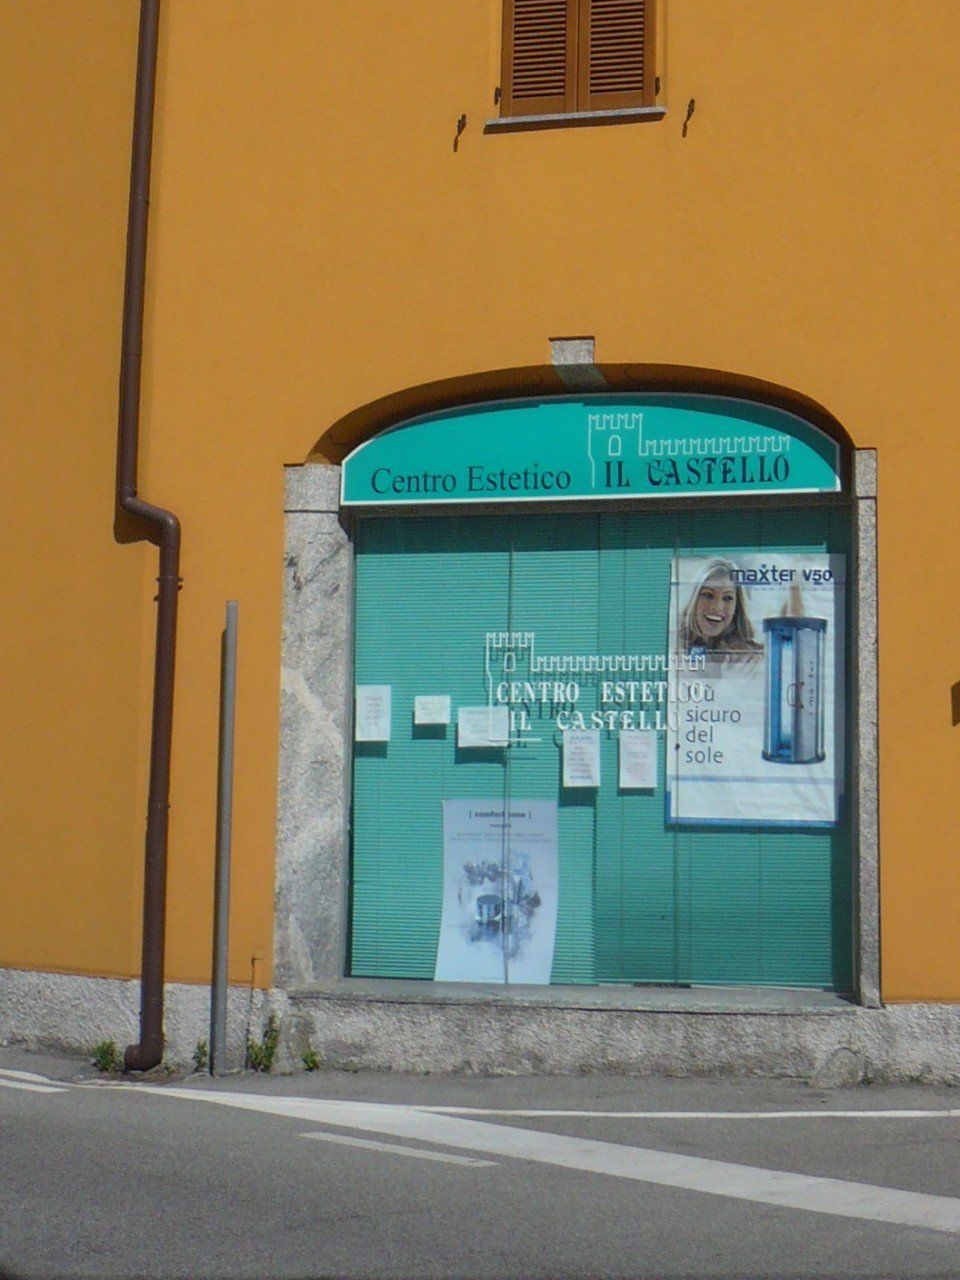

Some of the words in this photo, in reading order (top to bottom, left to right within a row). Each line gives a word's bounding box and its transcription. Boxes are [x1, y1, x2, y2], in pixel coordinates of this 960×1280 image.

[370, 467, 457, 494] Centro
[467, 462, 572, 492] Estetico
[604, 460, 631, 488] IL
[647, 454, 790, 486] CASTELLO
[730, 563, 796, 583] maxter
[496, 681, 580, 703] CENTRO
[601, 681, 704, 704] ESTETICO
[510, 711, 532, 731] IL
[556, 710, 678, 732] CASTELLO
[685, 706, 742, 723] sicuro
[685, 726, 714, 743] del
[685, 746, 724, 764] sole
